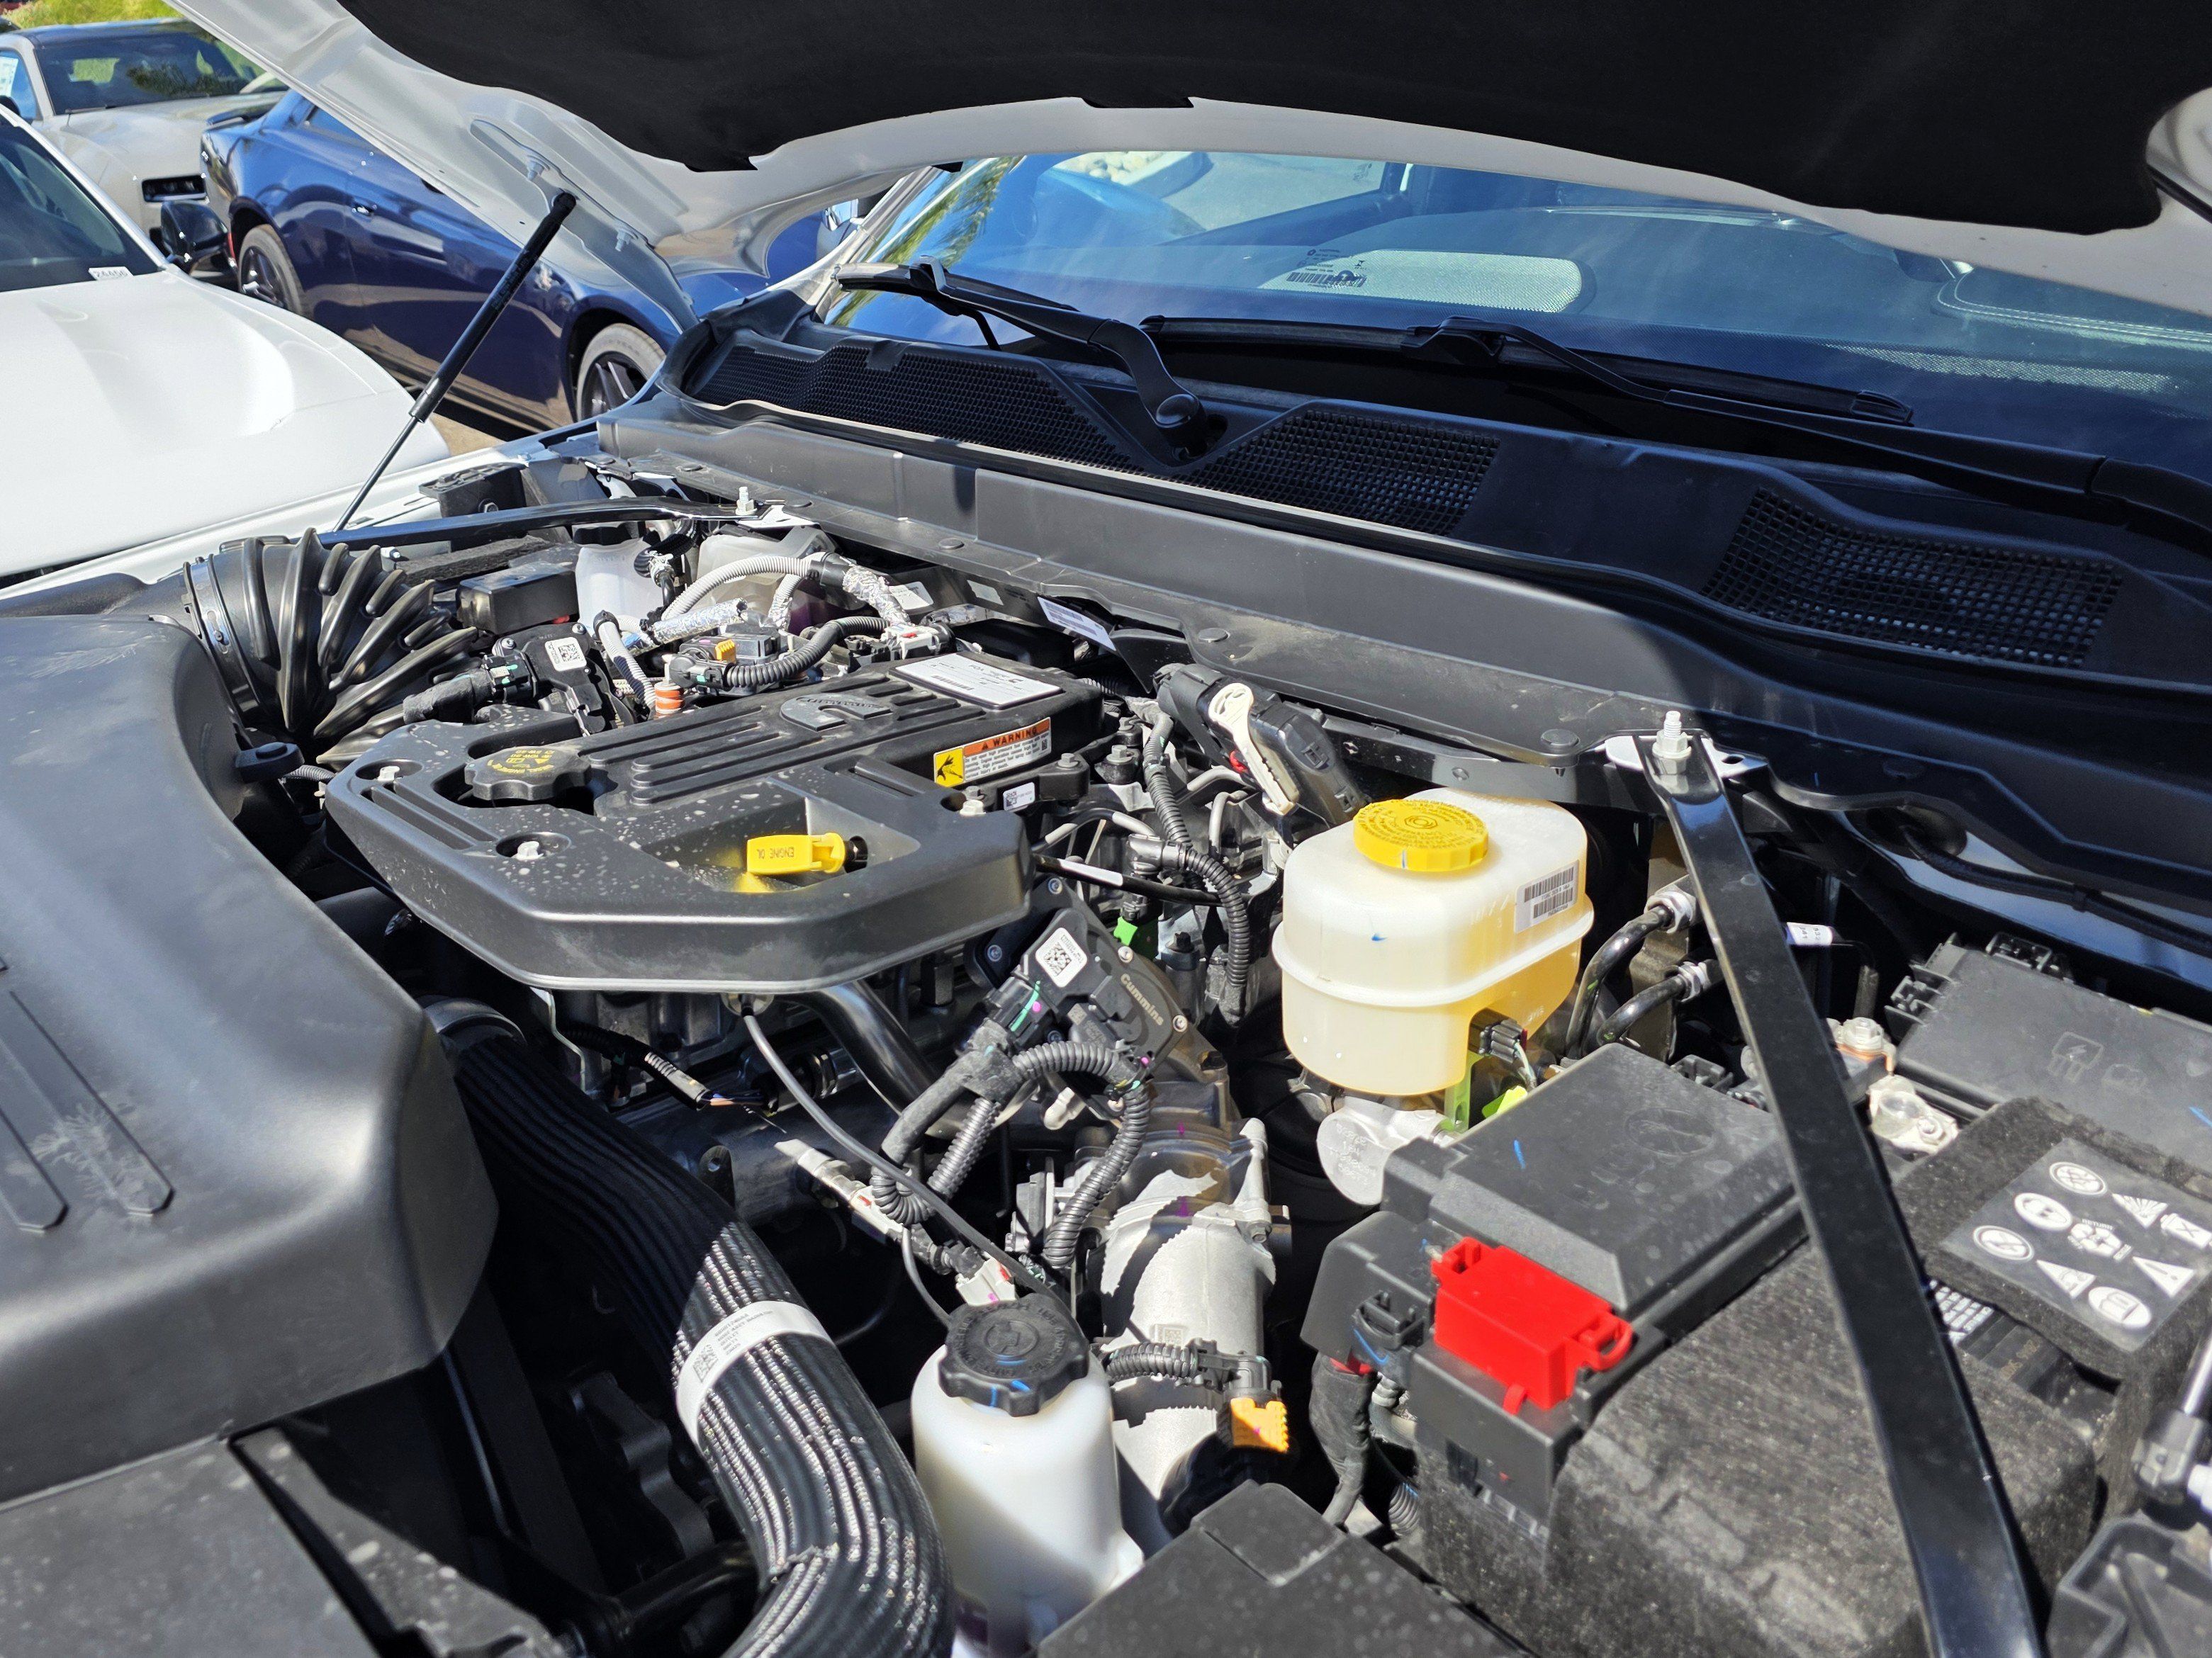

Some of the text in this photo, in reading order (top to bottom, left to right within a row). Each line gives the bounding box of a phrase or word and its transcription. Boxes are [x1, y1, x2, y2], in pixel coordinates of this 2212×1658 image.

[992, 727, 1038, 747] WARNING
[770, 847, 795, 859] ENGINE
[1121, 974, 1164, 1025] Cummins
